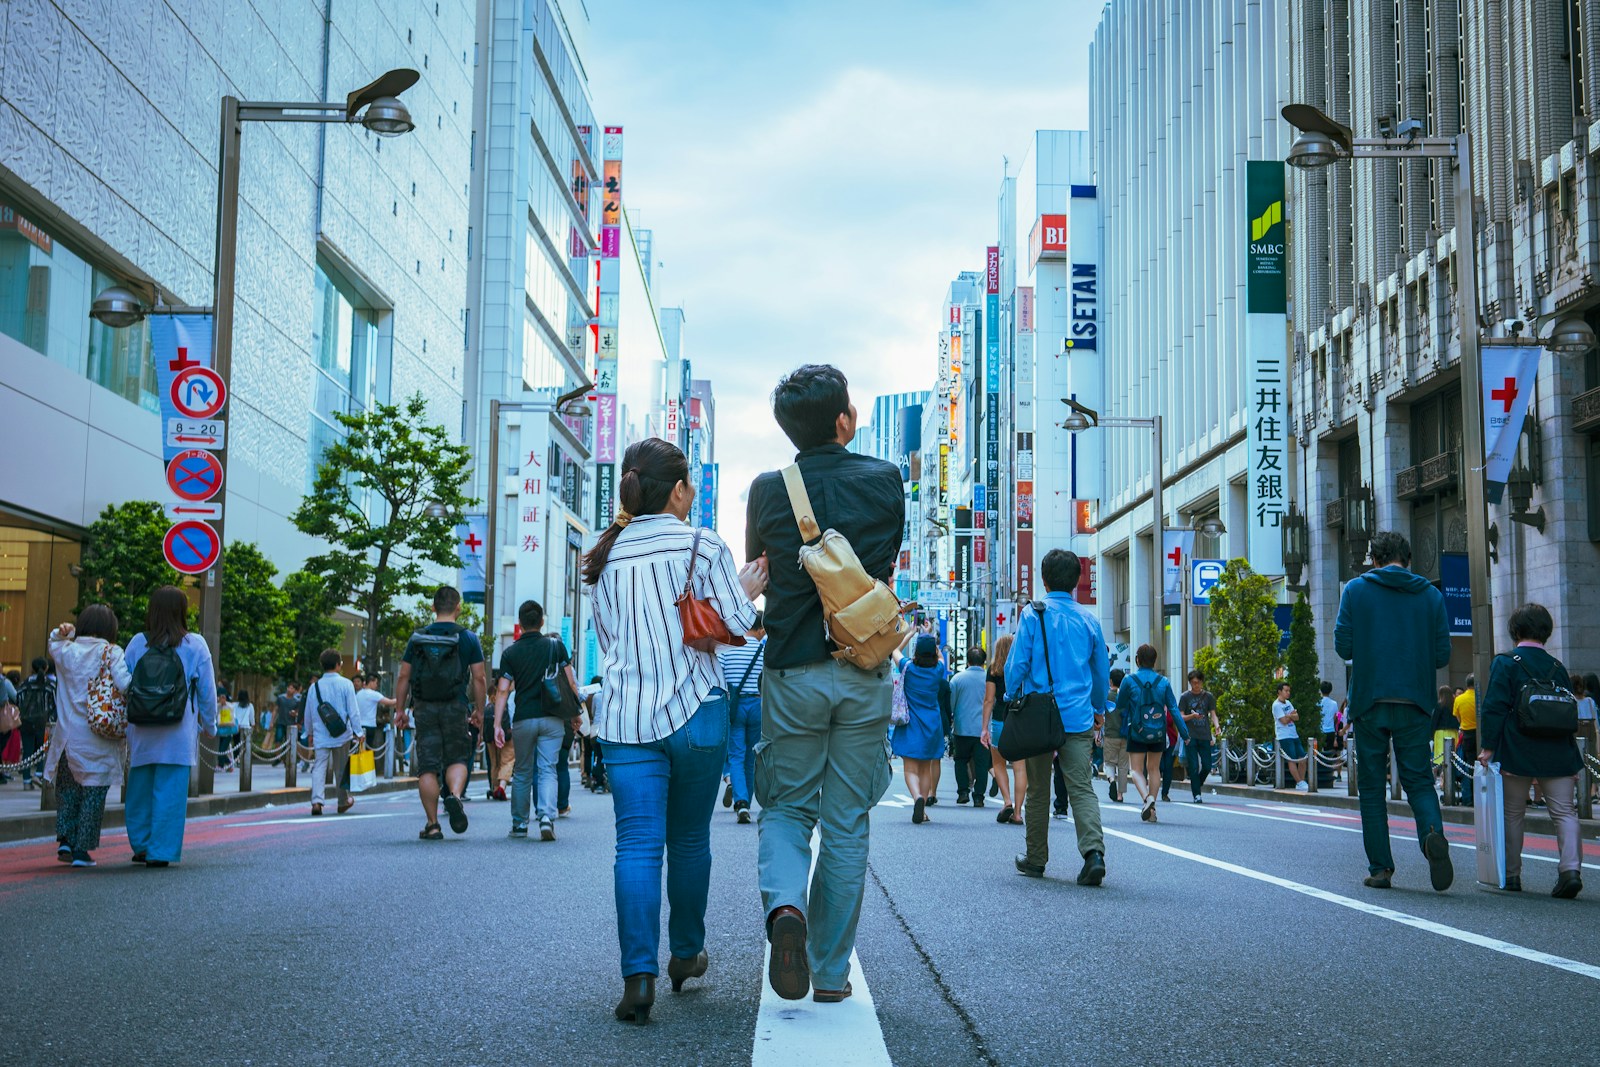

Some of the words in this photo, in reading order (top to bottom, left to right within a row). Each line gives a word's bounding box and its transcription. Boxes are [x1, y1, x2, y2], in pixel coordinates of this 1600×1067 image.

[989, 252, 998, 290] アカネビル
[1250, 243, 1284, 254] SMBC
[1065, 264, 1097, 352] ISETAN
[600, 397, 613, 460] シェーキーズ
[1255, 359, 1283, 528] 三井住友銀行
[523, 450, 541, 553] 大和証券
